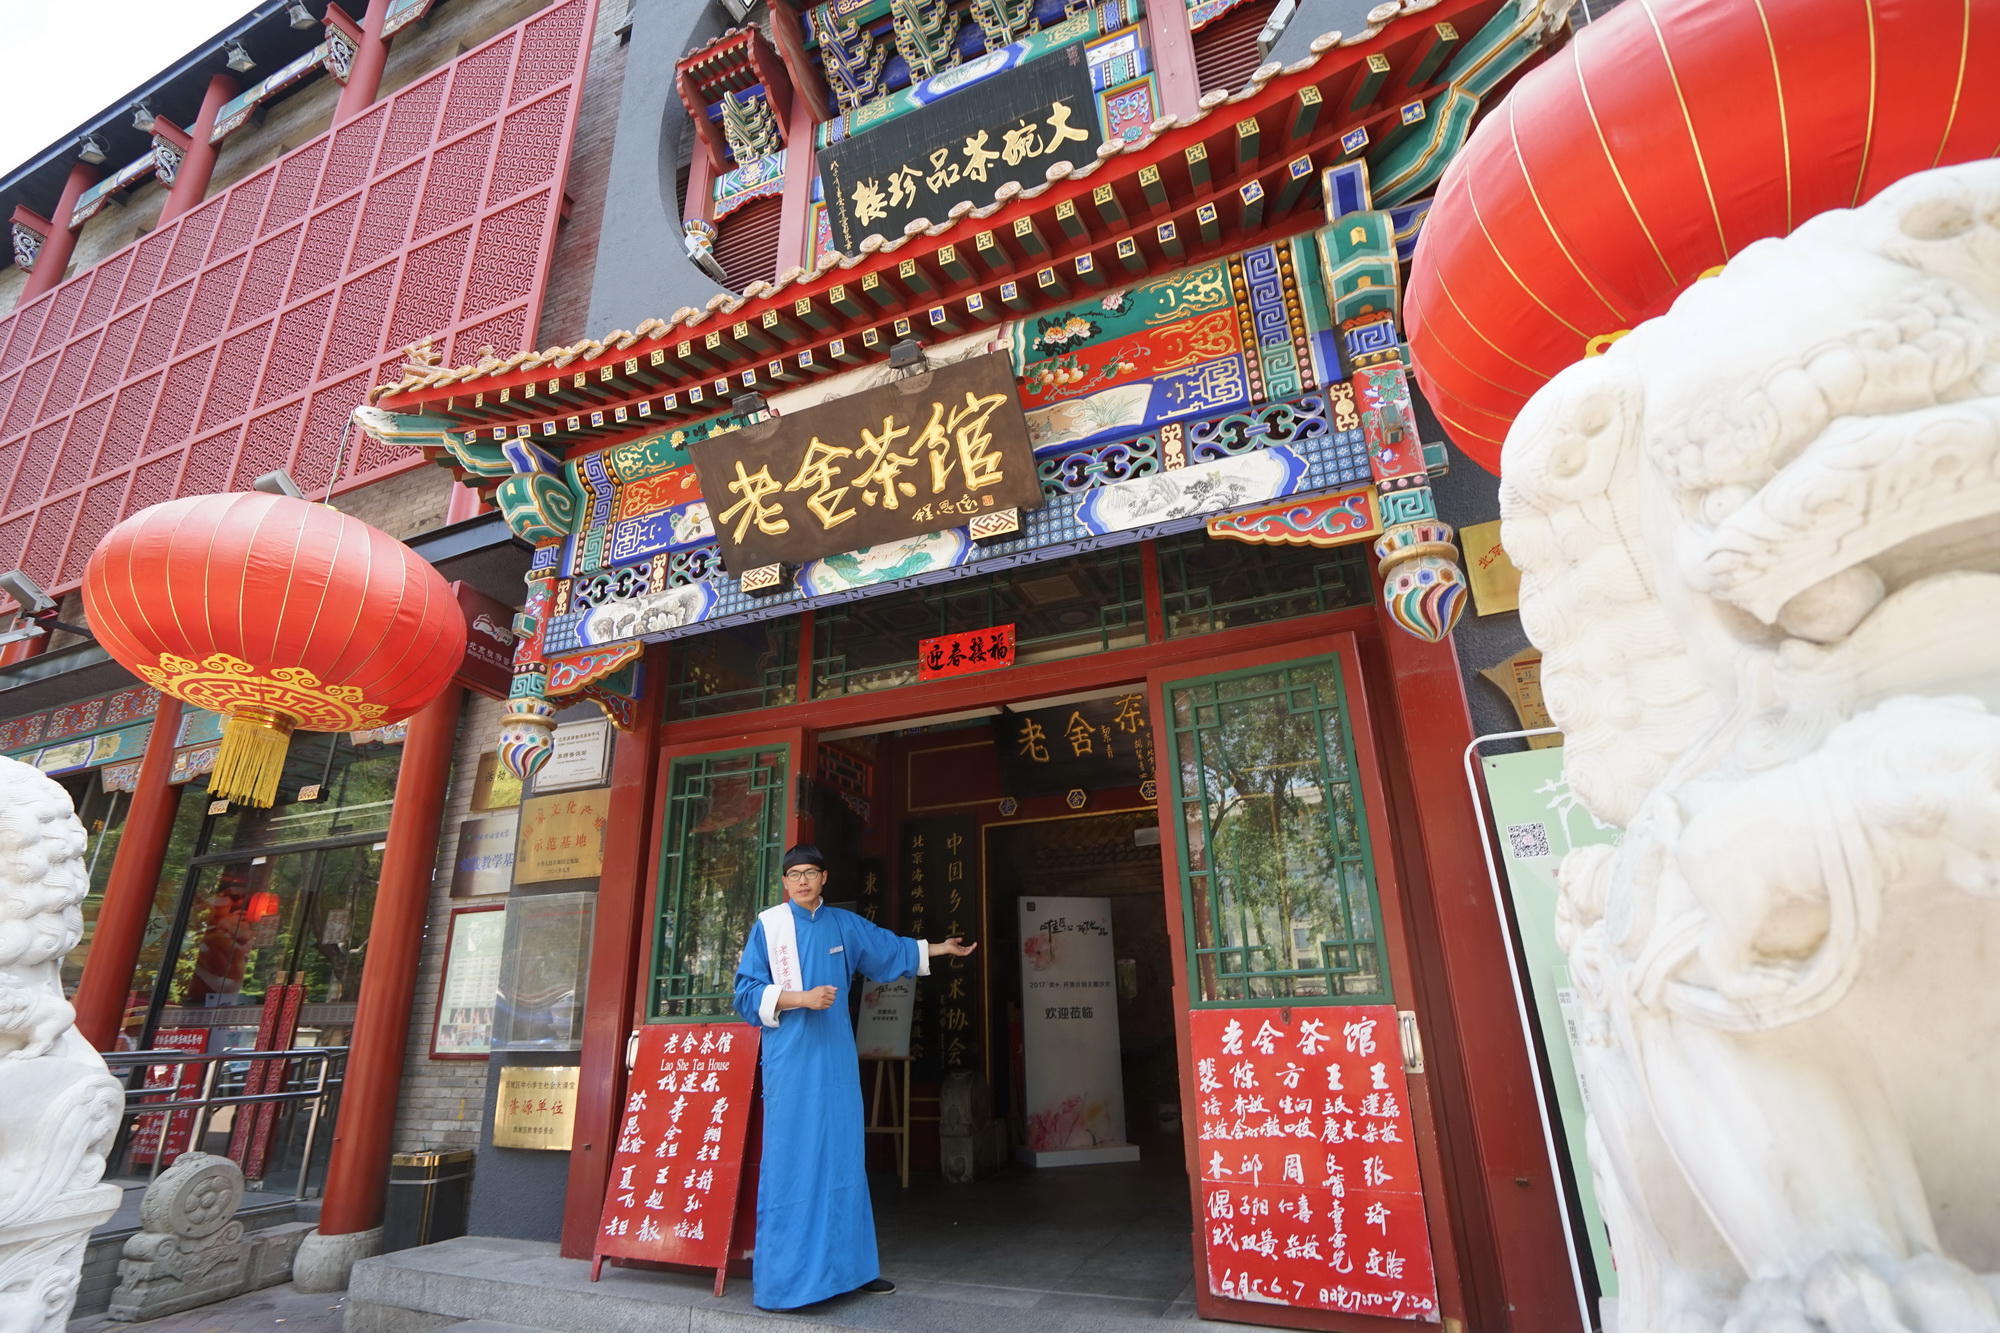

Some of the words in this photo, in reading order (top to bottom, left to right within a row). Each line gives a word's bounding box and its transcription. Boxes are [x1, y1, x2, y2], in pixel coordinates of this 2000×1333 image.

[718, 391, 1008, 545] 老舍茶馆
[927, 632, 1009, 671] 迎春接福
[663, 1030, 734, 1055] 老舍茶馆
[1220, 1015, 1378, 1057] 老舍茶馆
[660, 1058, 675, 1072] Lao
[675, 1058, 690, 1072] She
[692, 1058, 705, 1072] Tea
[707, 1058, 730, 1072] House
